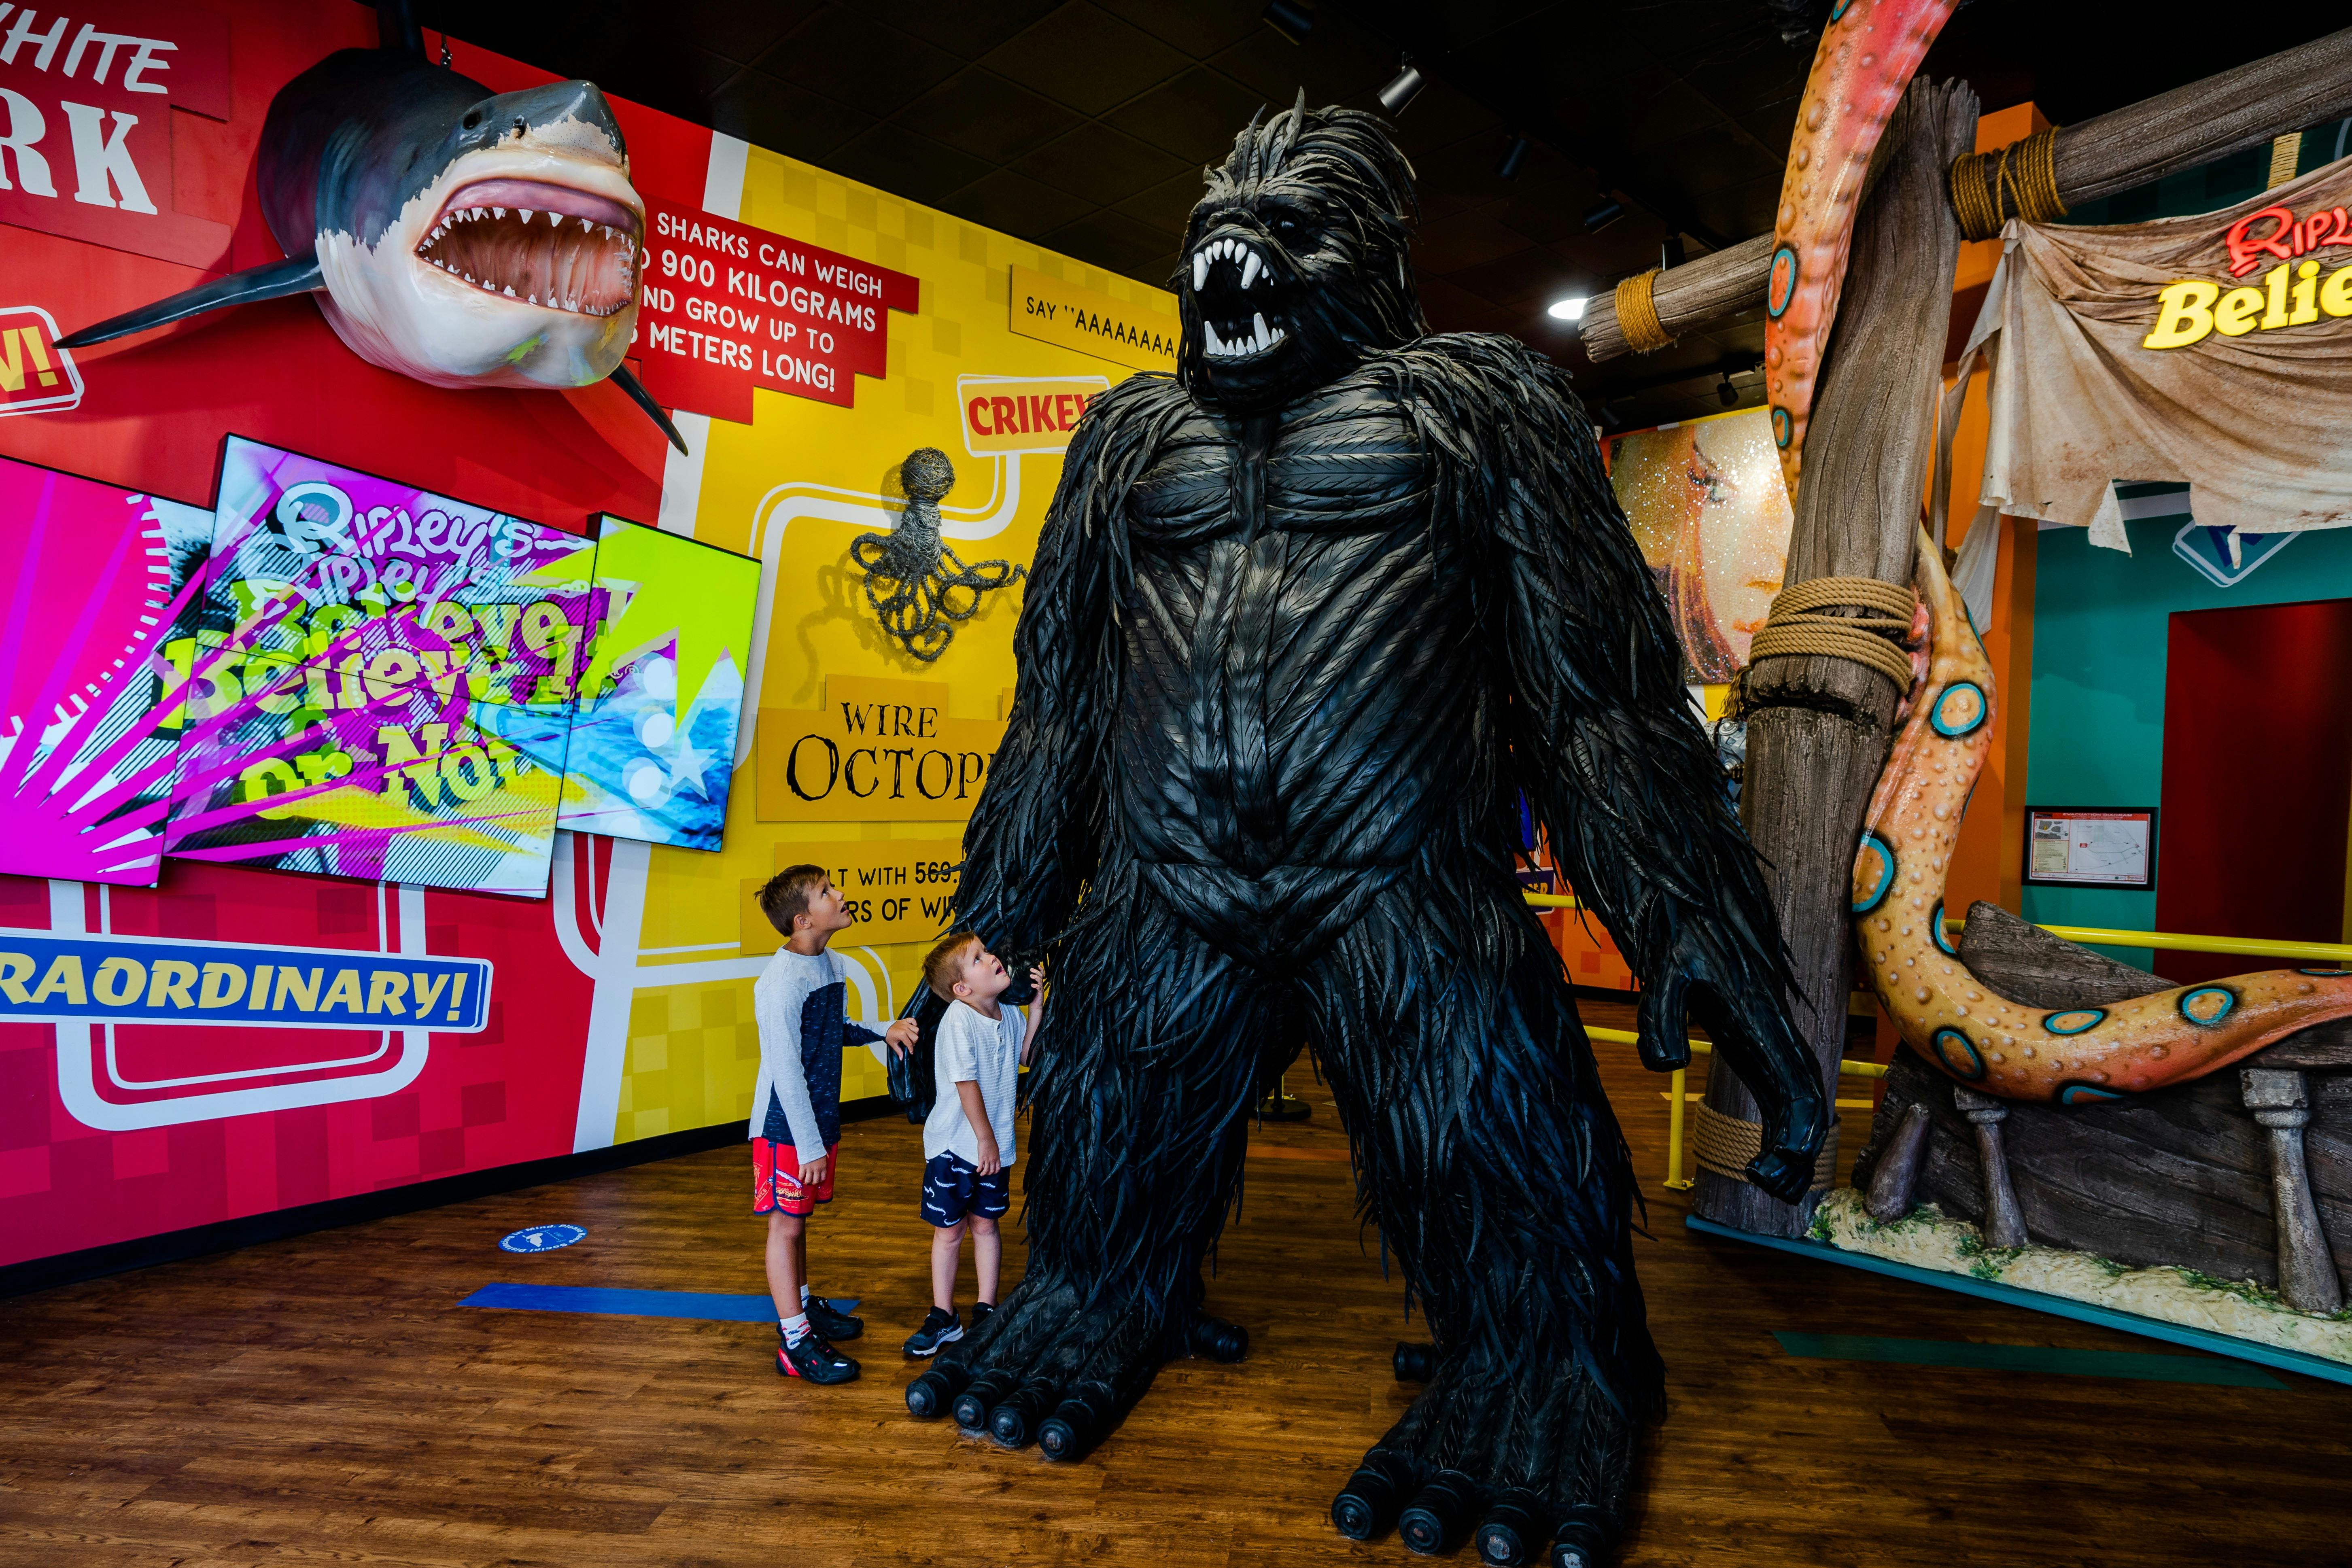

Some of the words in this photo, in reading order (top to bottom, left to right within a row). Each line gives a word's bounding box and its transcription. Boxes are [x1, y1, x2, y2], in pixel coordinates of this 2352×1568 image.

[657, 212, 749, 259] SHARKS
[759, 244, 805, 276] CAN
[815, 259, 882, 299] WEIGH
[2226, 207, 2352, 278] RIPL
[662, 249, 715, 287] 900
[728, 267, 876, 332] KILOGRAMS
[1026, 296, 1057, 320] SAY
[640, 284, 675, 313] ND
[686, 297, 760, 334] GROW
[770, 318, 797, 343] UP
[807, 328, 834, 354] TO
[650, 321, 753, 371] METERS
[762, 350, 835, 393] LONG!
[841, 702, 938, 738] WIRE
[786, 734, 995, 801] OCTOP
[858, 866, 906, 886] WITH
[915, 861, 961, 884] 569.
[881, 898, 911, 921] OF
[0, 952, 468, 1022] RAORDINARY!
[529, 1243, 568, 1252] Social
[558, 1224, 584, 1233] Please
[568, 1232, 586, 1243] Keep
